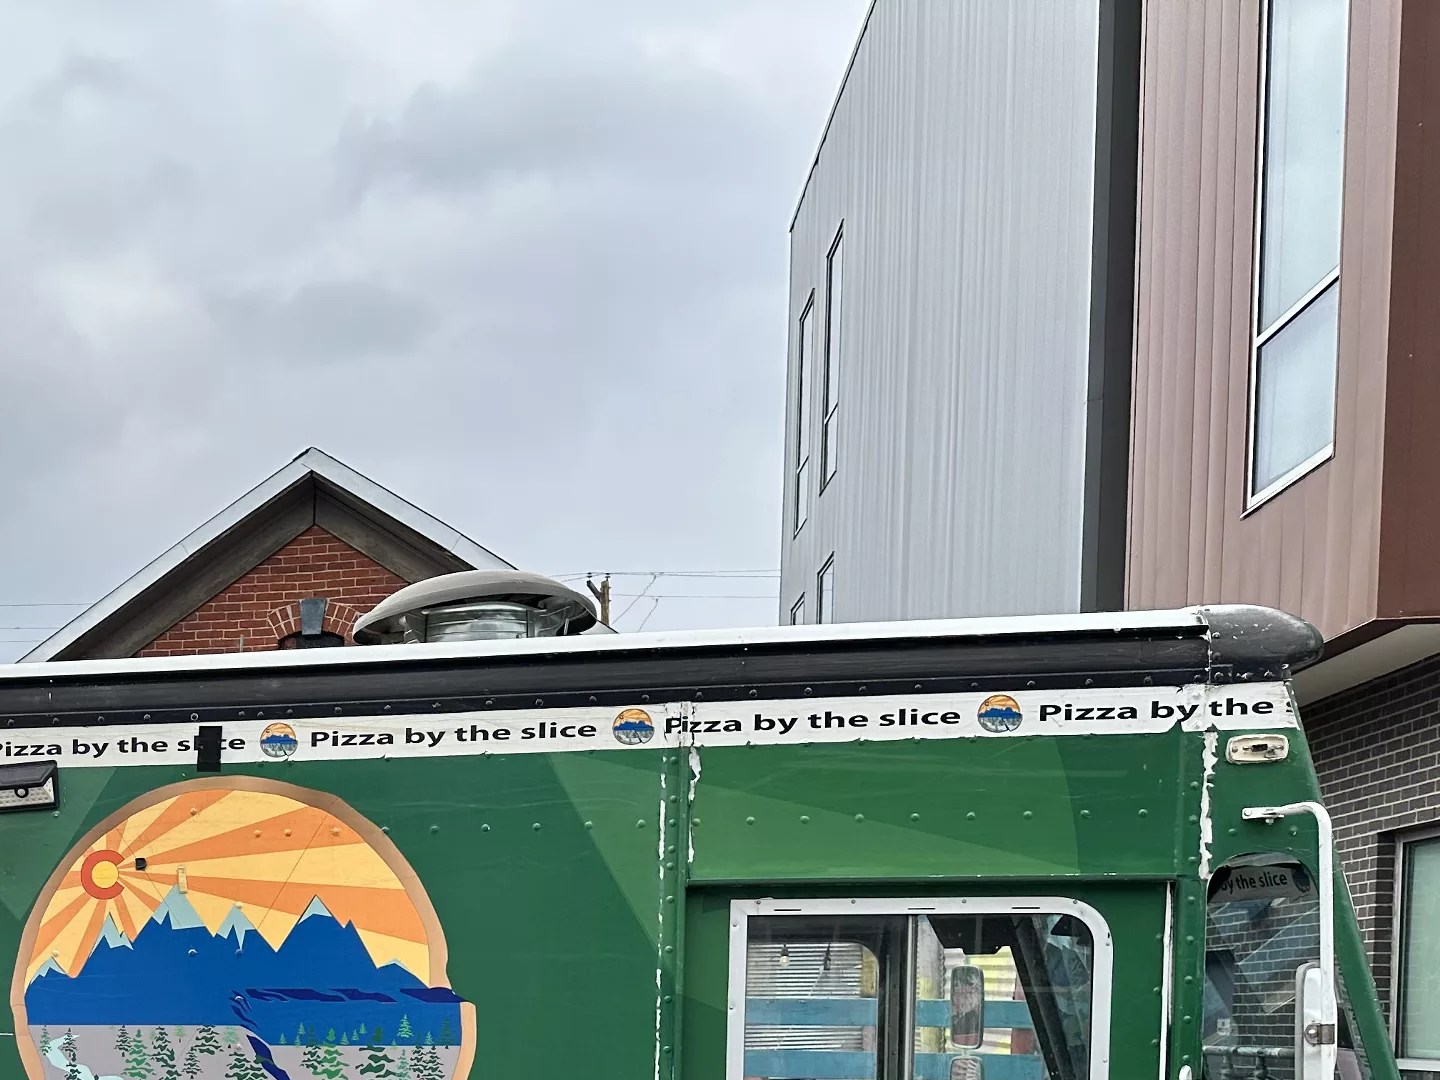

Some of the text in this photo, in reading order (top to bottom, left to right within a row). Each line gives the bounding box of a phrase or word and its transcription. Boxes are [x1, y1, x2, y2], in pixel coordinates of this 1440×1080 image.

[1039, 703, 1138, 721] Pizza
[1150, 700, 1198, 721] by
[1210, 697, 1274, 717] the
[665, 708, 961, 735] Pizza by the slice
[310, 721, 597, 747] Pizza by the slice
[72, 739, 109, 759] by
[117, 737, 168, 753] the
[1235, 874, 1257, 890] the
[1259, 871, 1288, 887] slice
